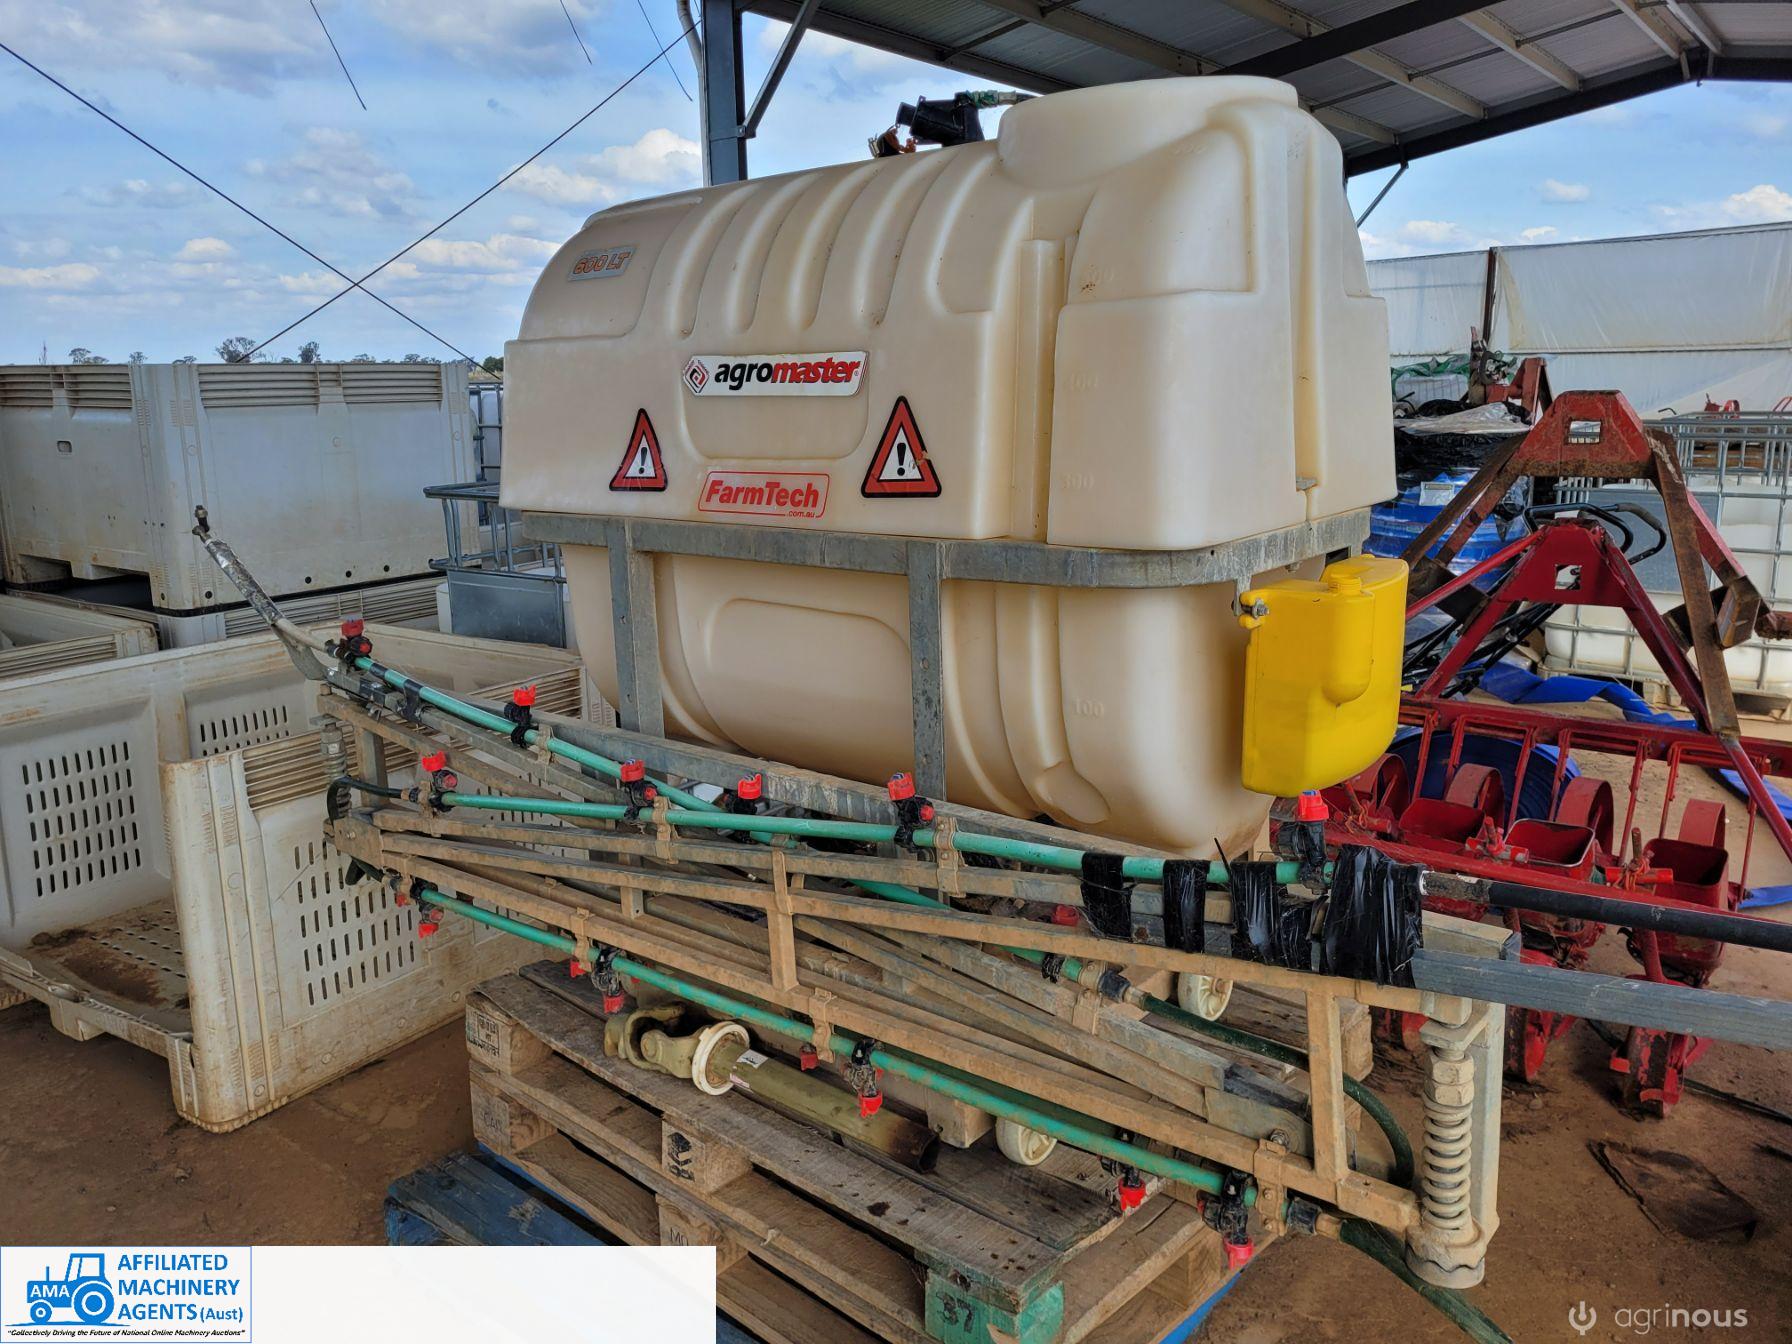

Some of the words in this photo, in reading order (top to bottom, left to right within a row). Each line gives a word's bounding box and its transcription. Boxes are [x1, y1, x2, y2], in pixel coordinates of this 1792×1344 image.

[573, 254, 609, 275] 600
[606, 251, 632, 271] LT
[714, 357, 862, 391] agromaster
[706, 479, 820, 508] FarmTech
